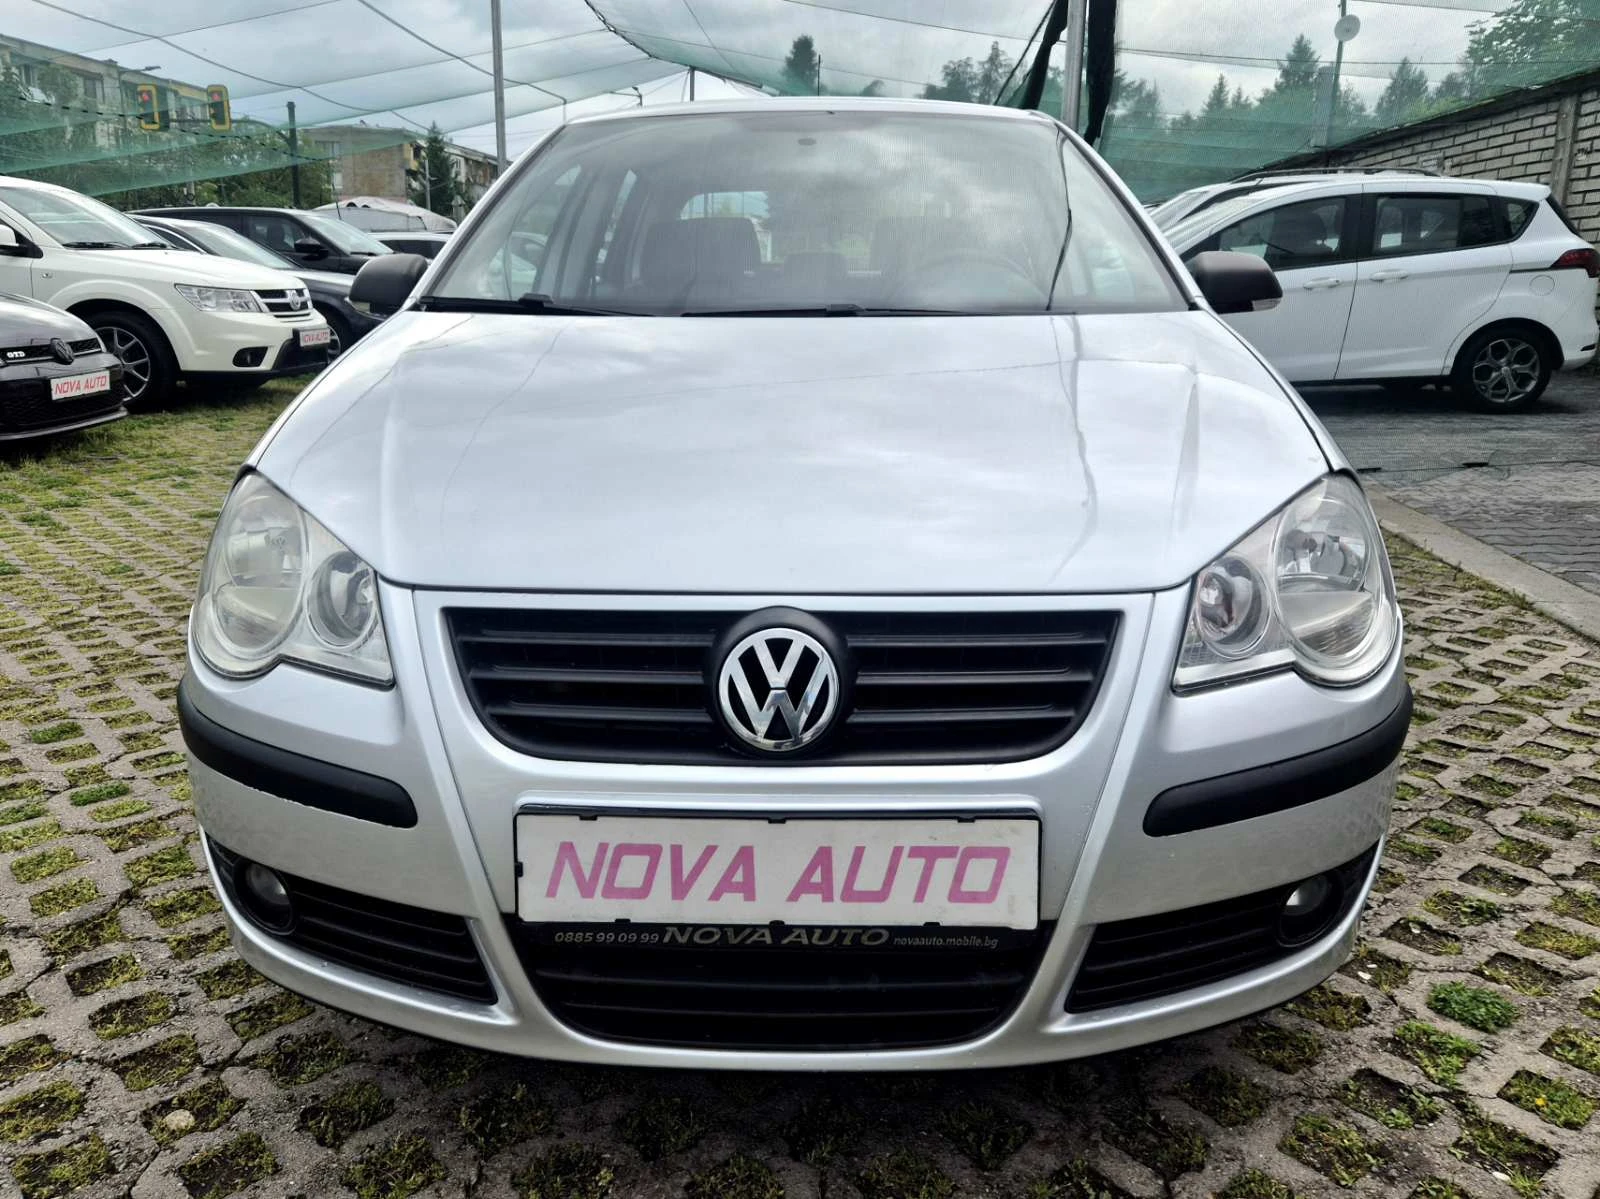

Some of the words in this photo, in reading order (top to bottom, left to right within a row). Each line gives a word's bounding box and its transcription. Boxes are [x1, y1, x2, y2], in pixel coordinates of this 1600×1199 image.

[55, 380, 81, 394] NOVA
[84, 375, 107, 390] AUTO
[545, 841, 757, 902] NOVA
[786, 845, 1011, 904] AUTO
[554, 931, 594, 943] 0885
[595, 931, 616, 943] 99
[617, 932, 638, 943] 09
[639, 932, 660, 944] 99
[662, 926, 774, 945] NOVA
[780, 928, 891, 946] AUTO
[892, 934, 999, 950] novaauto.mobile.bg
